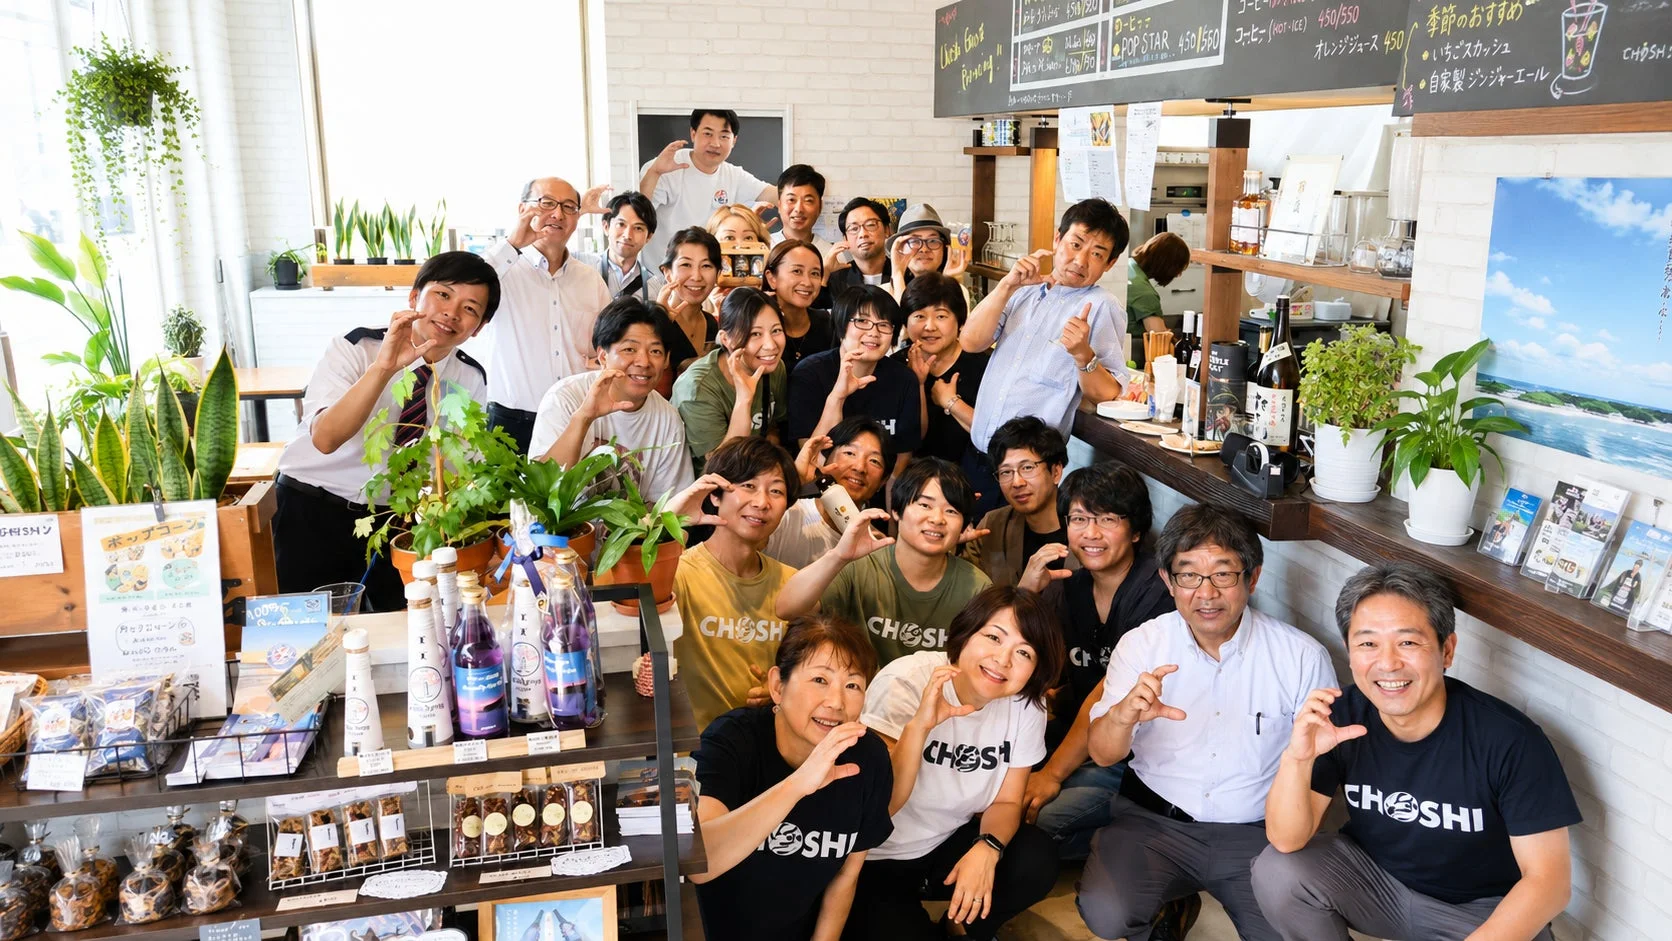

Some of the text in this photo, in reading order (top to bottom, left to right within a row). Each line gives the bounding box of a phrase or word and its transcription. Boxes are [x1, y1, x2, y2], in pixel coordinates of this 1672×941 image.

[1318, 5, 1360, 30] 450/550
[1426, 1, 1523, 38] 季節のおすすめ
[1121, 35, 1140, 61] POP
[1141, 30, 1170, 54] STAR
[1313, 30, 1405, 60] オレンジジュース 450
[1432, 38, 1512, 62] いちごスカッシュ
[1344, 784, 1484, 832] CHOSHI
